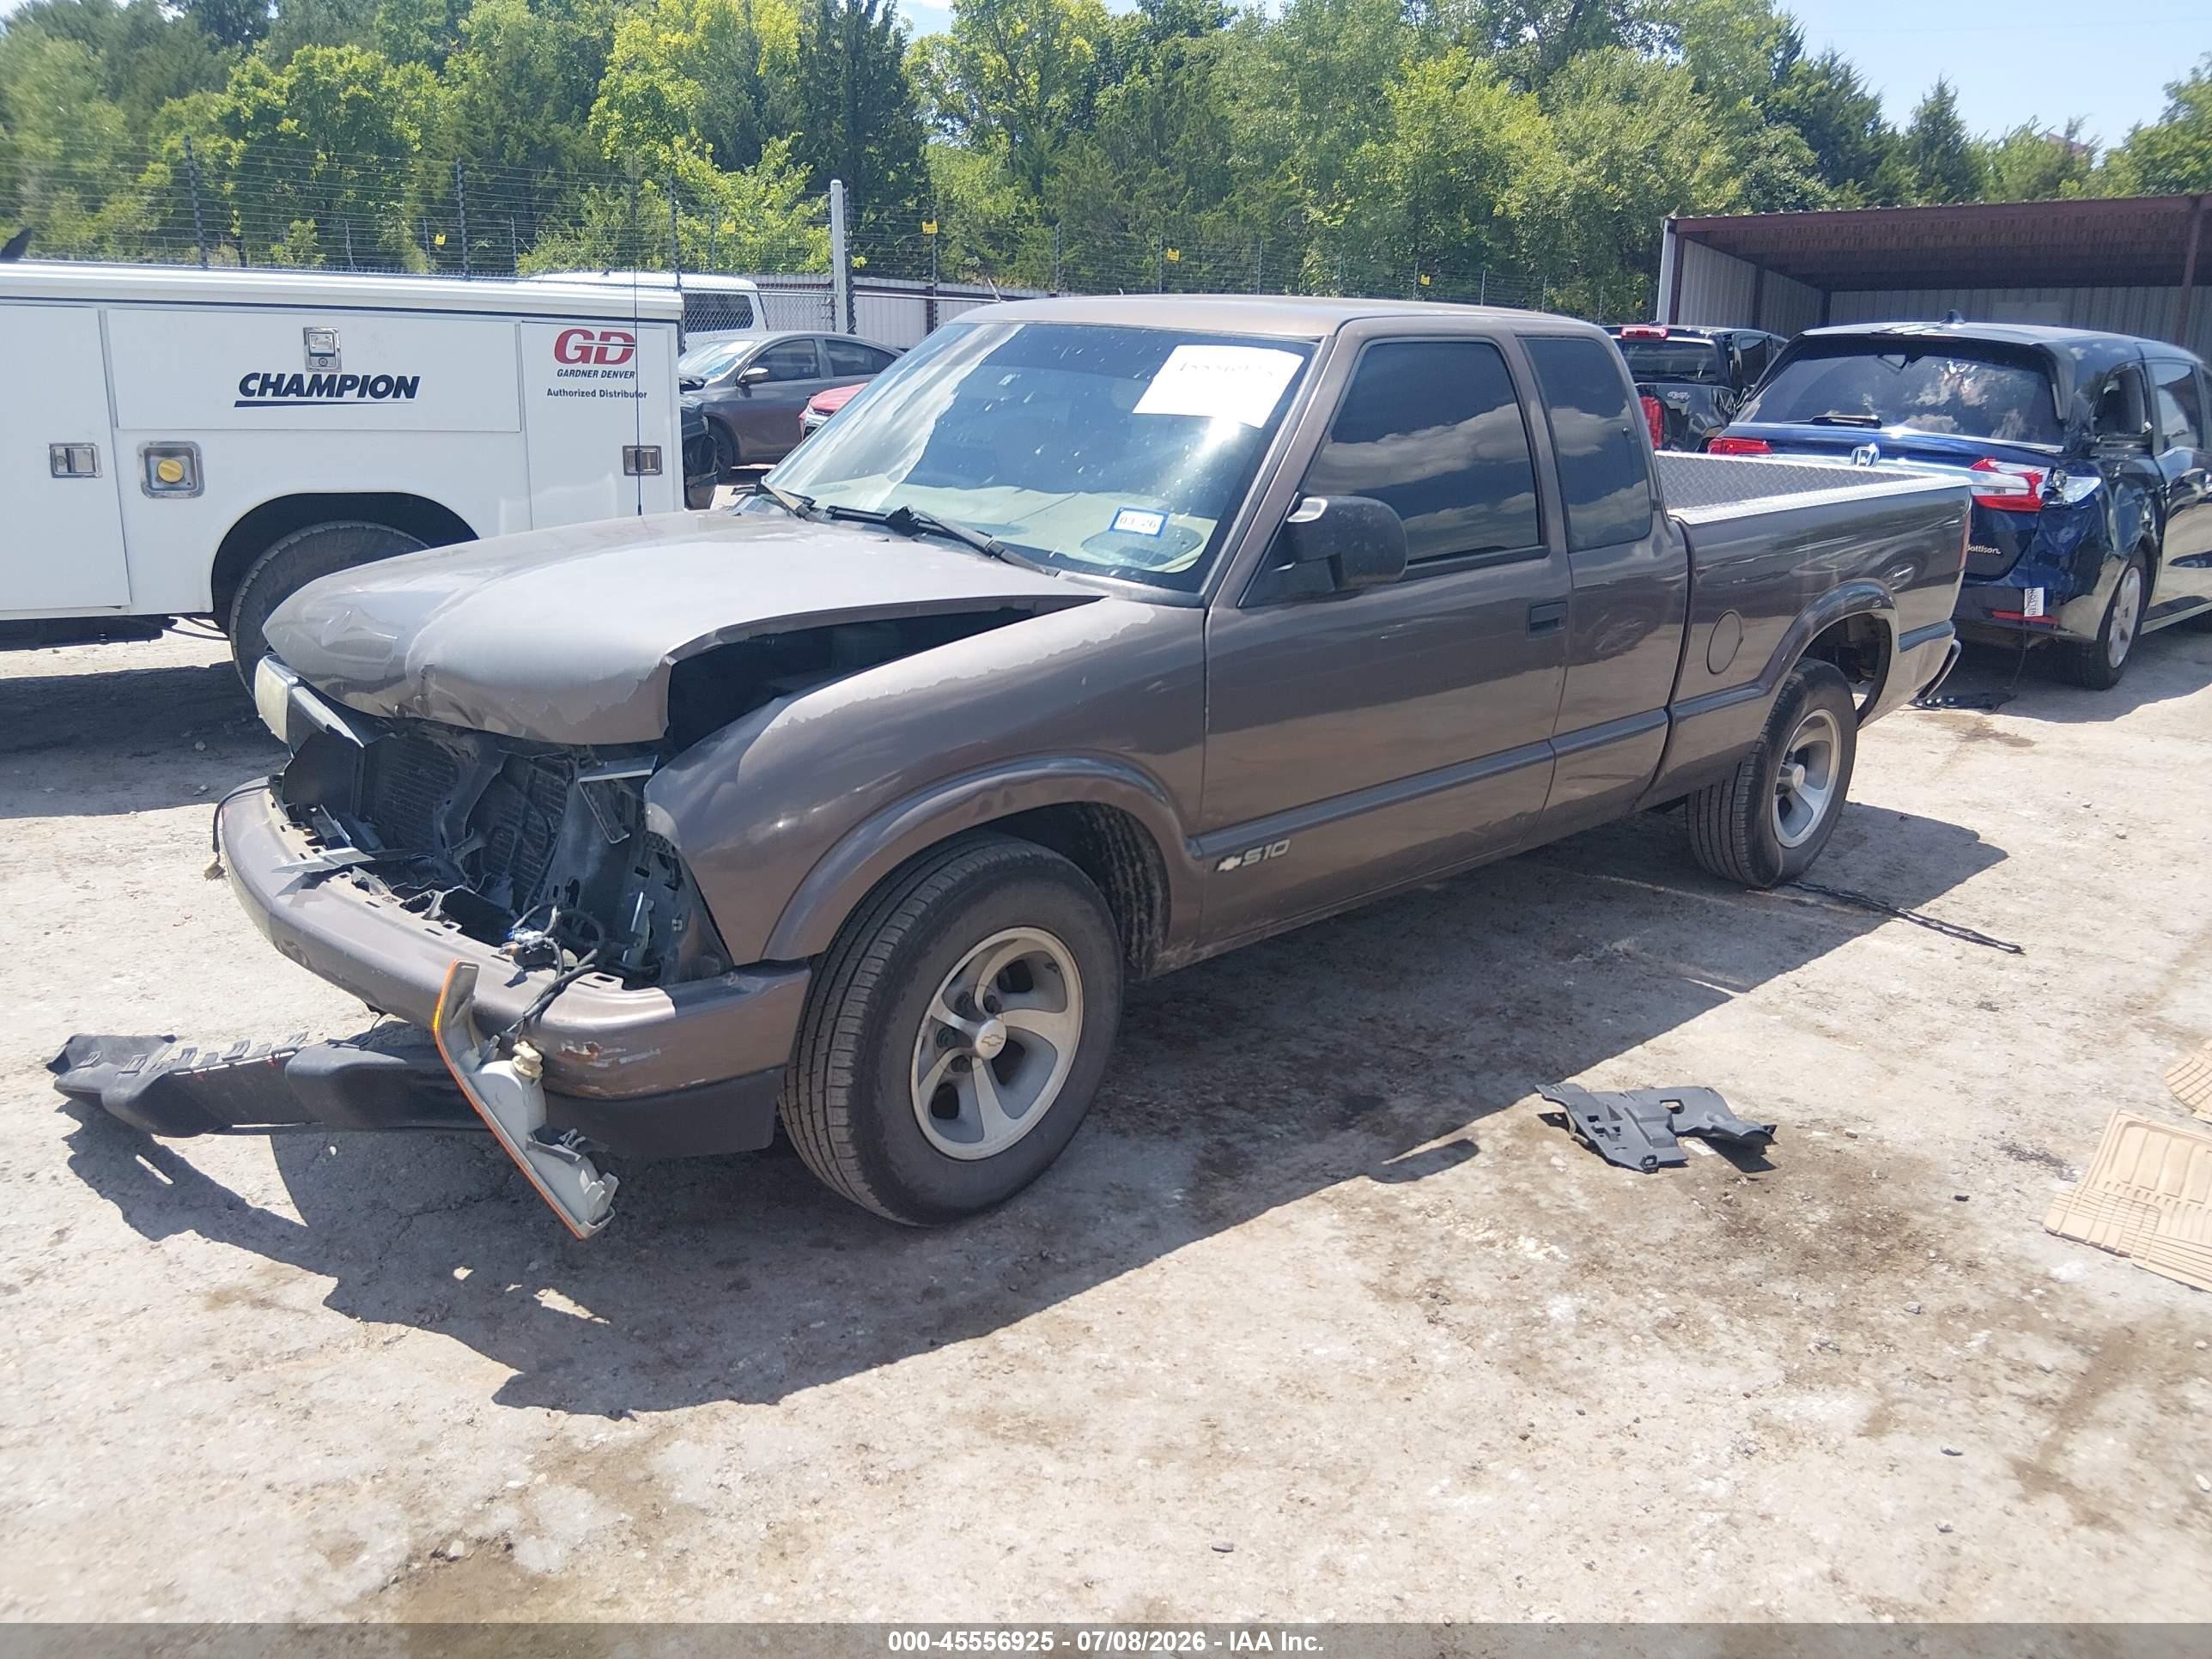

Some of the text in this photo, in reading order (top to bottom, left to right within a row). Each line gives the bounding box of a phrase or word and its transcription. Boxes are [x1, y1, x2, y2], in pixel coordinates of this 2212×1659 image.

[554, 328, 635, 365] GD
[239, 372, 421, 399] CHAMPION
[556, 368, 635, 379] GARDNER DENVER
[547, 387, 597, 398] Authorized
[1242, 839, 1291, 867] S10
